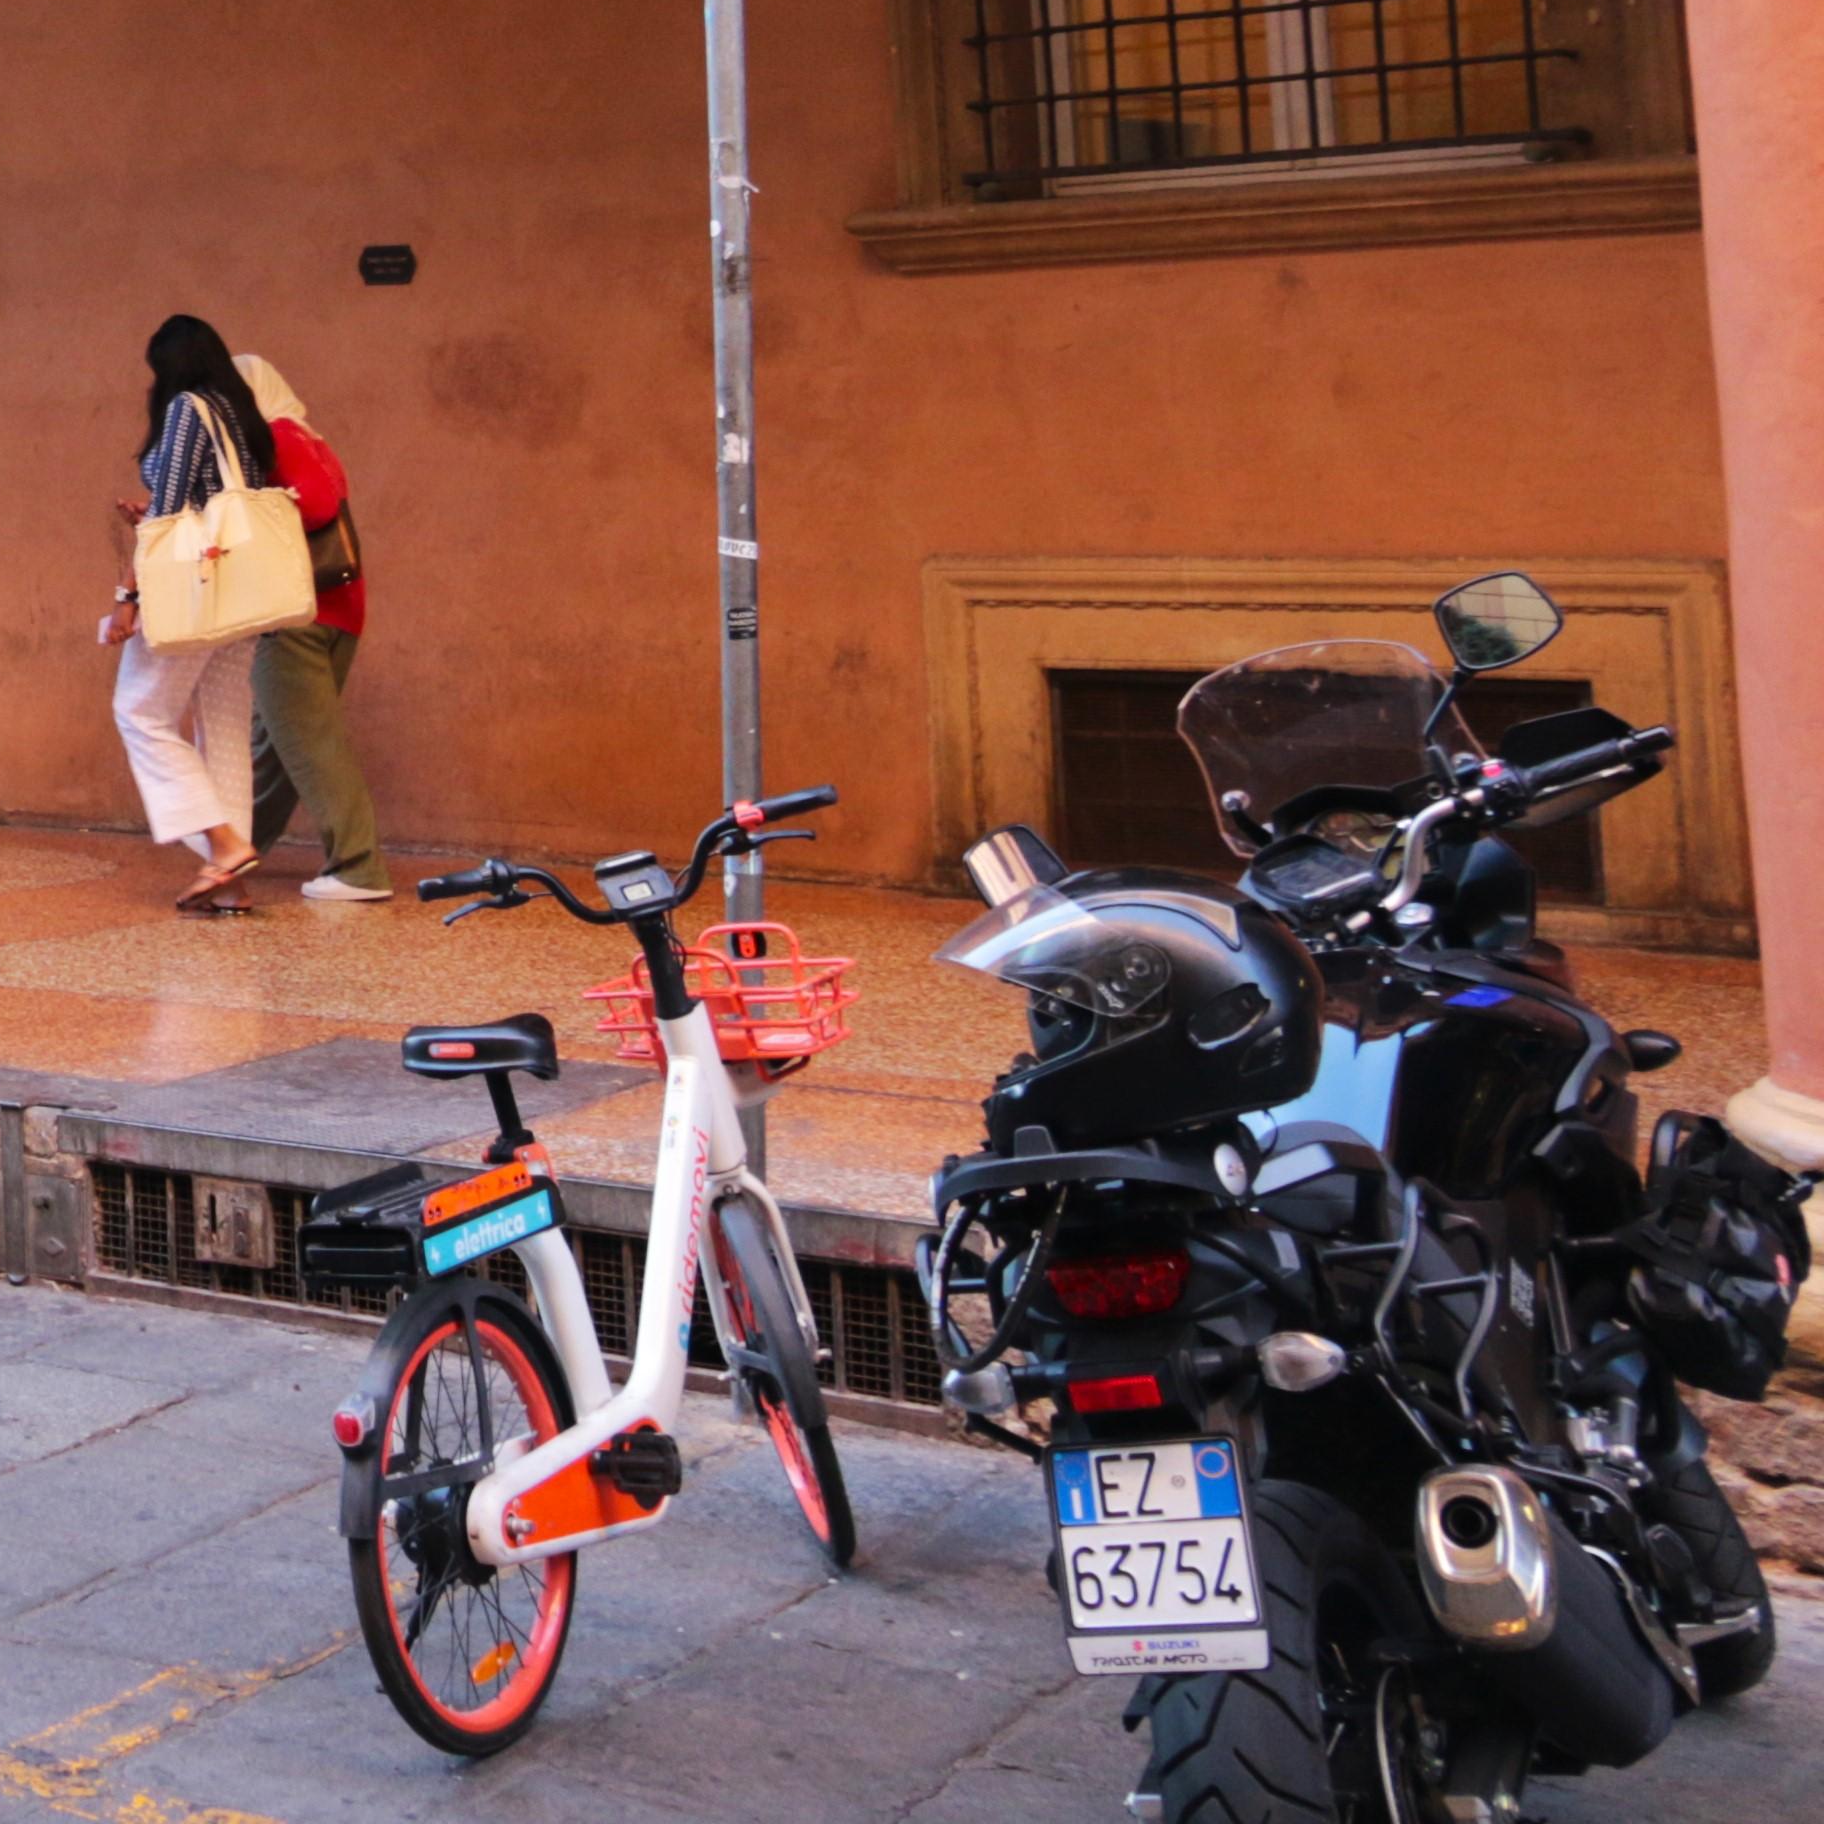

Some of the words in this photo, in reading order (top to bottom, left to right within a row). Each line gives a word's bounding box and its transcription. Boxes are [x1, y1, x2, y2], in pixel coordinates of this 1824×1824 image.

[455, 1211, 526, 1260] elettrica
[677, 1124, 710, 1318] ridemovi
[1094, 1452, 1164, 1518] EZ
[1071, 1537, 1242, 1610] 63754
[1147, 1639, 1200, 1650] SUZUKI
